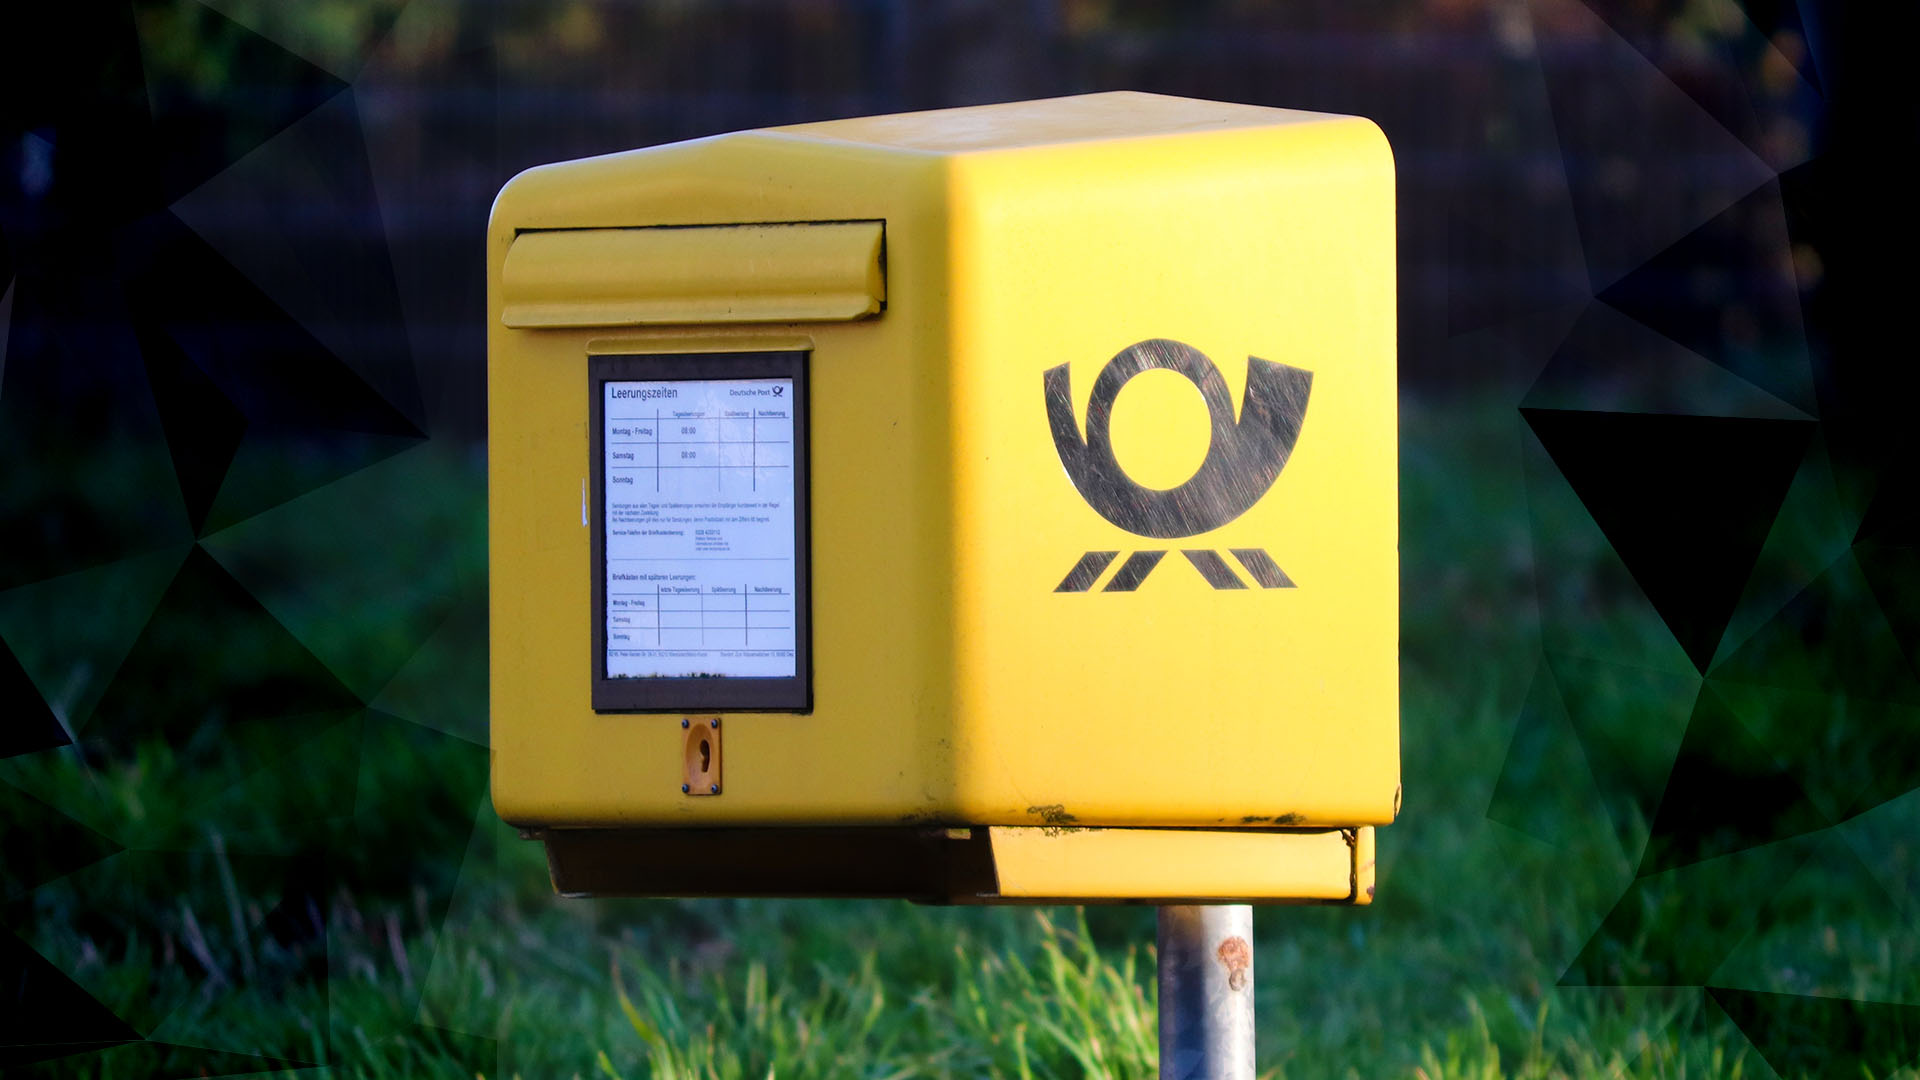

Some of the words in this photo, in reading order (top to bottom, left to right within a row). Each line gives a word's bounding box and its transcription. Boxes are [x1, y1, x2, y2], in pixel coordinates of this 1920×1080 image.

[611, 386, 678, 402] Leerungszeiten
[612, 427, 631, 436] Montag
[635, 427, 653, 436] Freitag
[612, 451, 634, 460] Samstag
[612, 476, 634, 485] Sonntag
